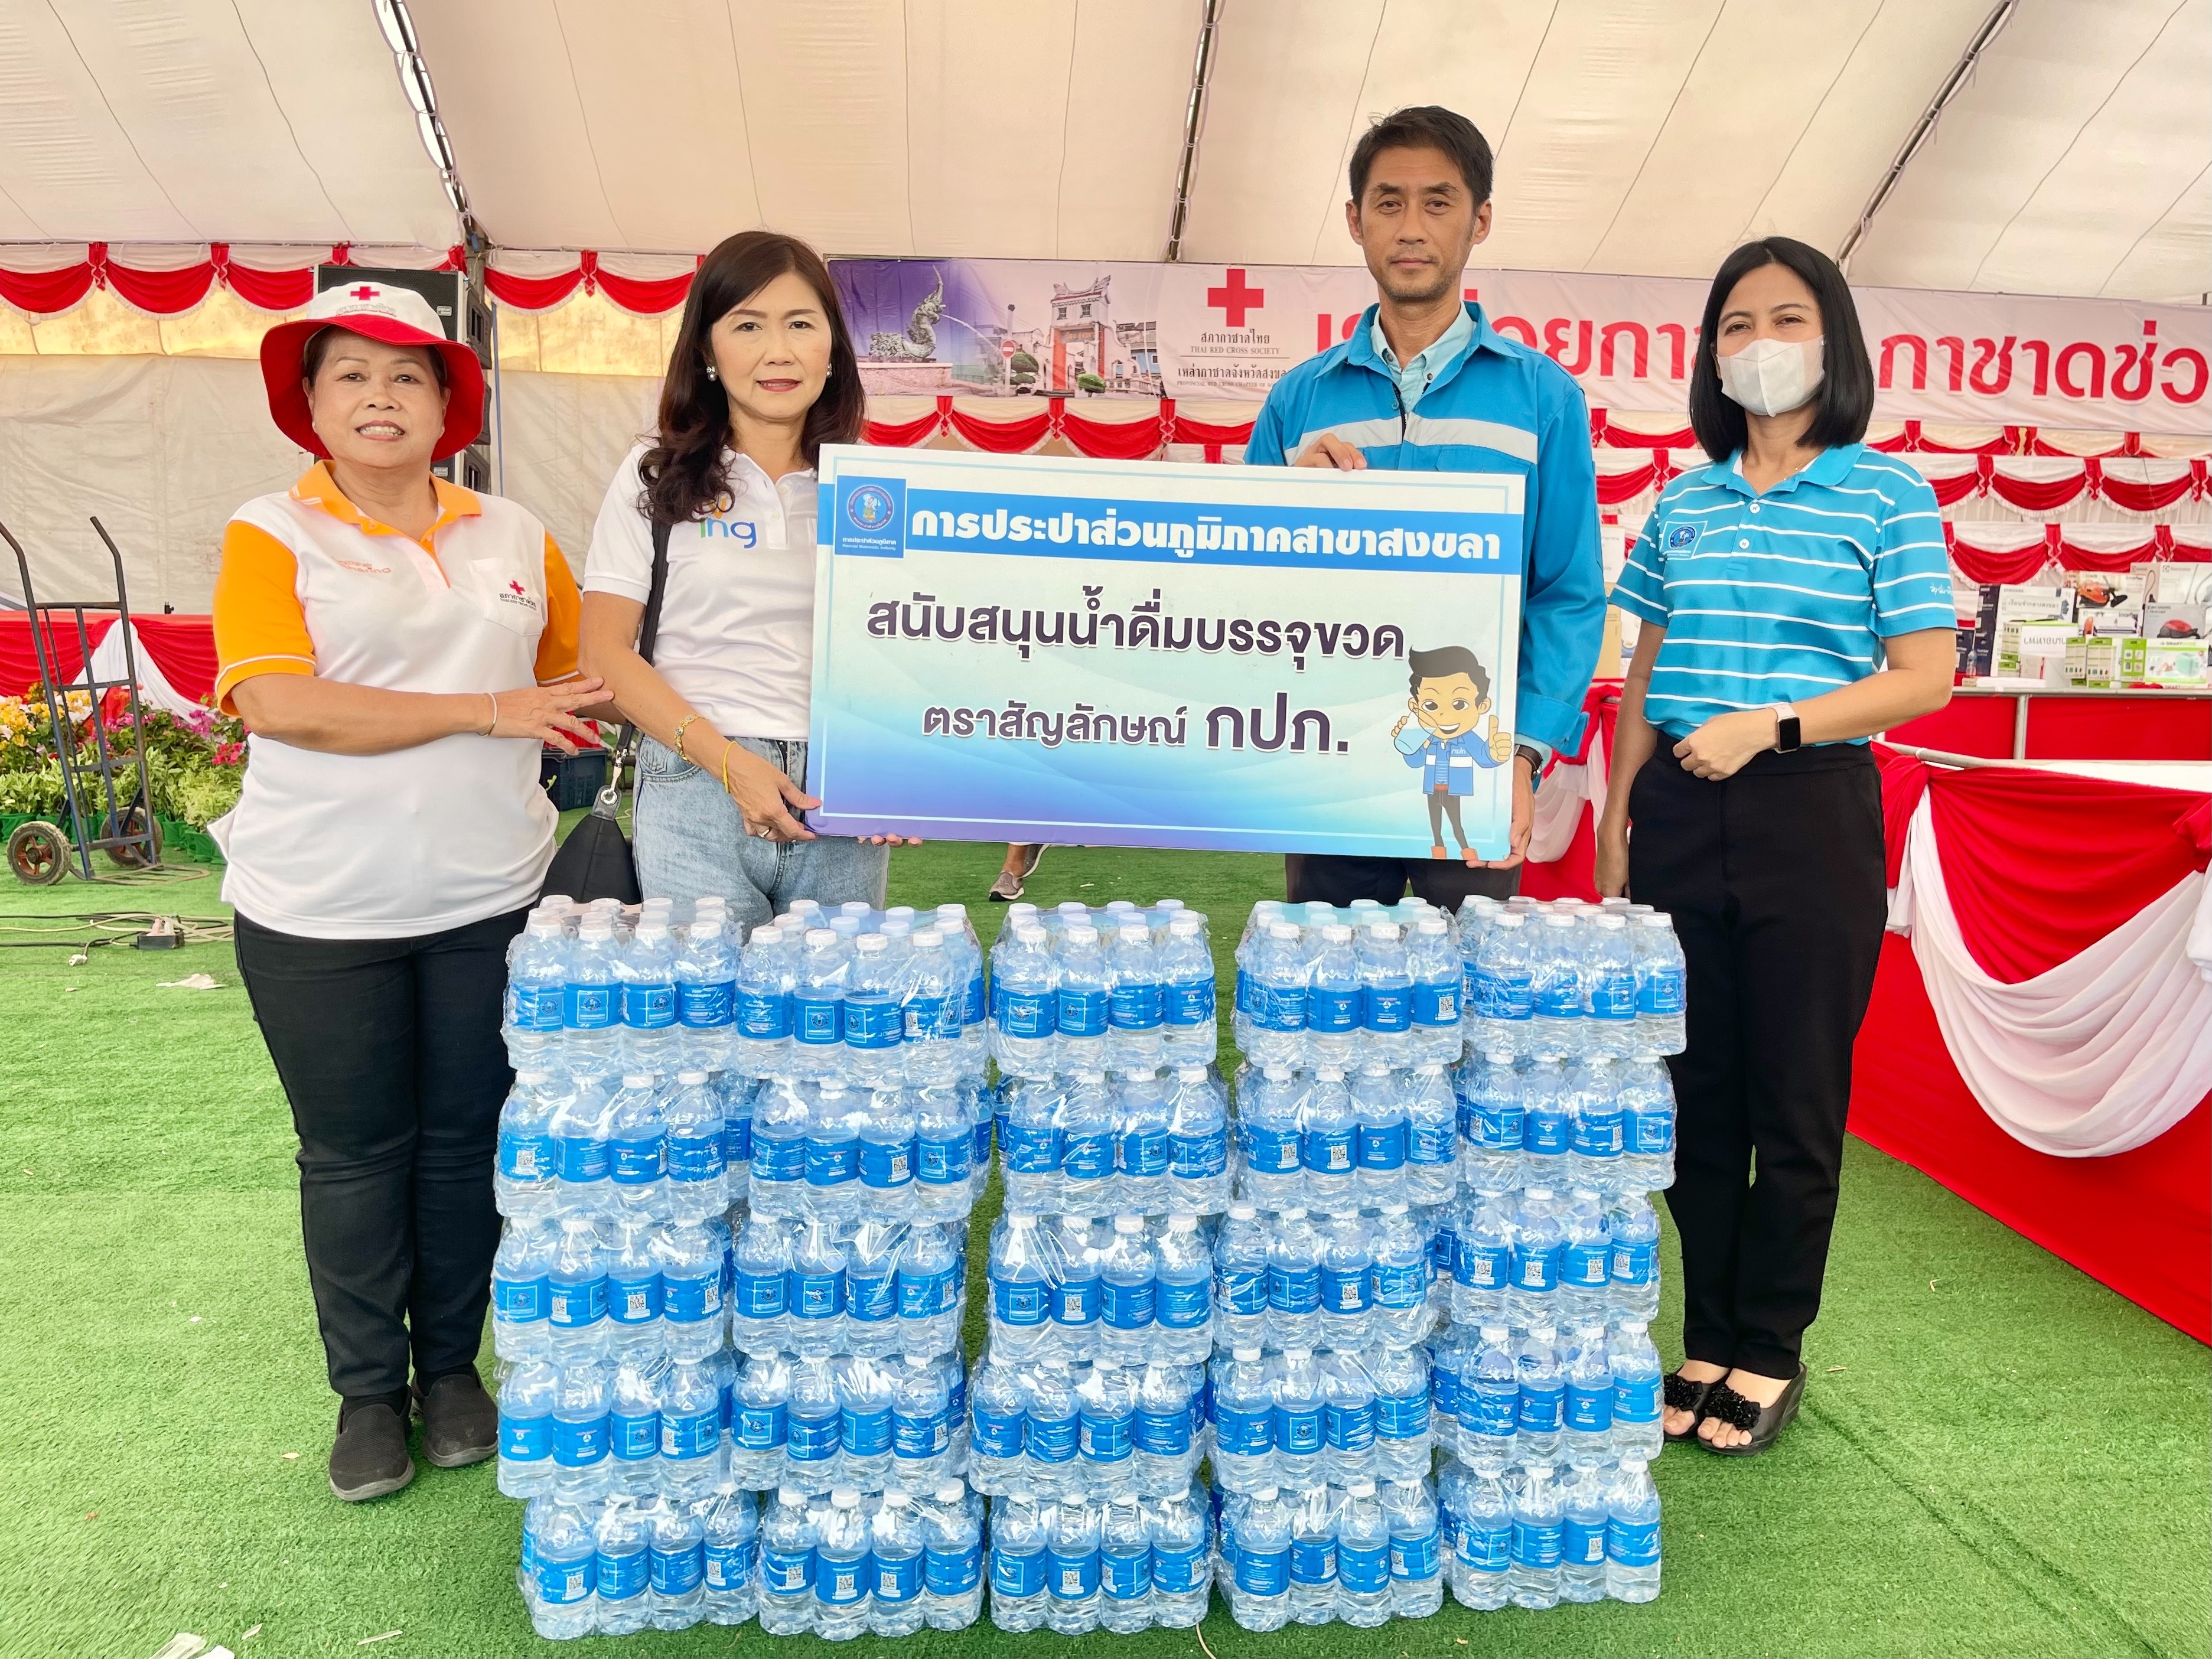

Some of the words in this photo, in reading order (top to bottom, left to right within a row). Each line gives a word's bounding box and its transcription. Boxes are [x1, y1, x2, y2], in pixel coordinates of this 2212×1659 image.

[1201, 328, 1270, 344] สภากาชาดไทย
[1178, 363, 1286, 379] เหล่ากาชาดจังหวัดสงขล
[912, 508, 1500, 560] การประปาส่วนภูมิภาคสาขาสงขลา
[867, 585, 1404, 672] สนับสนุนน้ำดื่มบรรจุขวด
[923, 699, 1187, 749] ตราสัญลักษณ์
[1206, 690, 1349, 754] กปภ.
